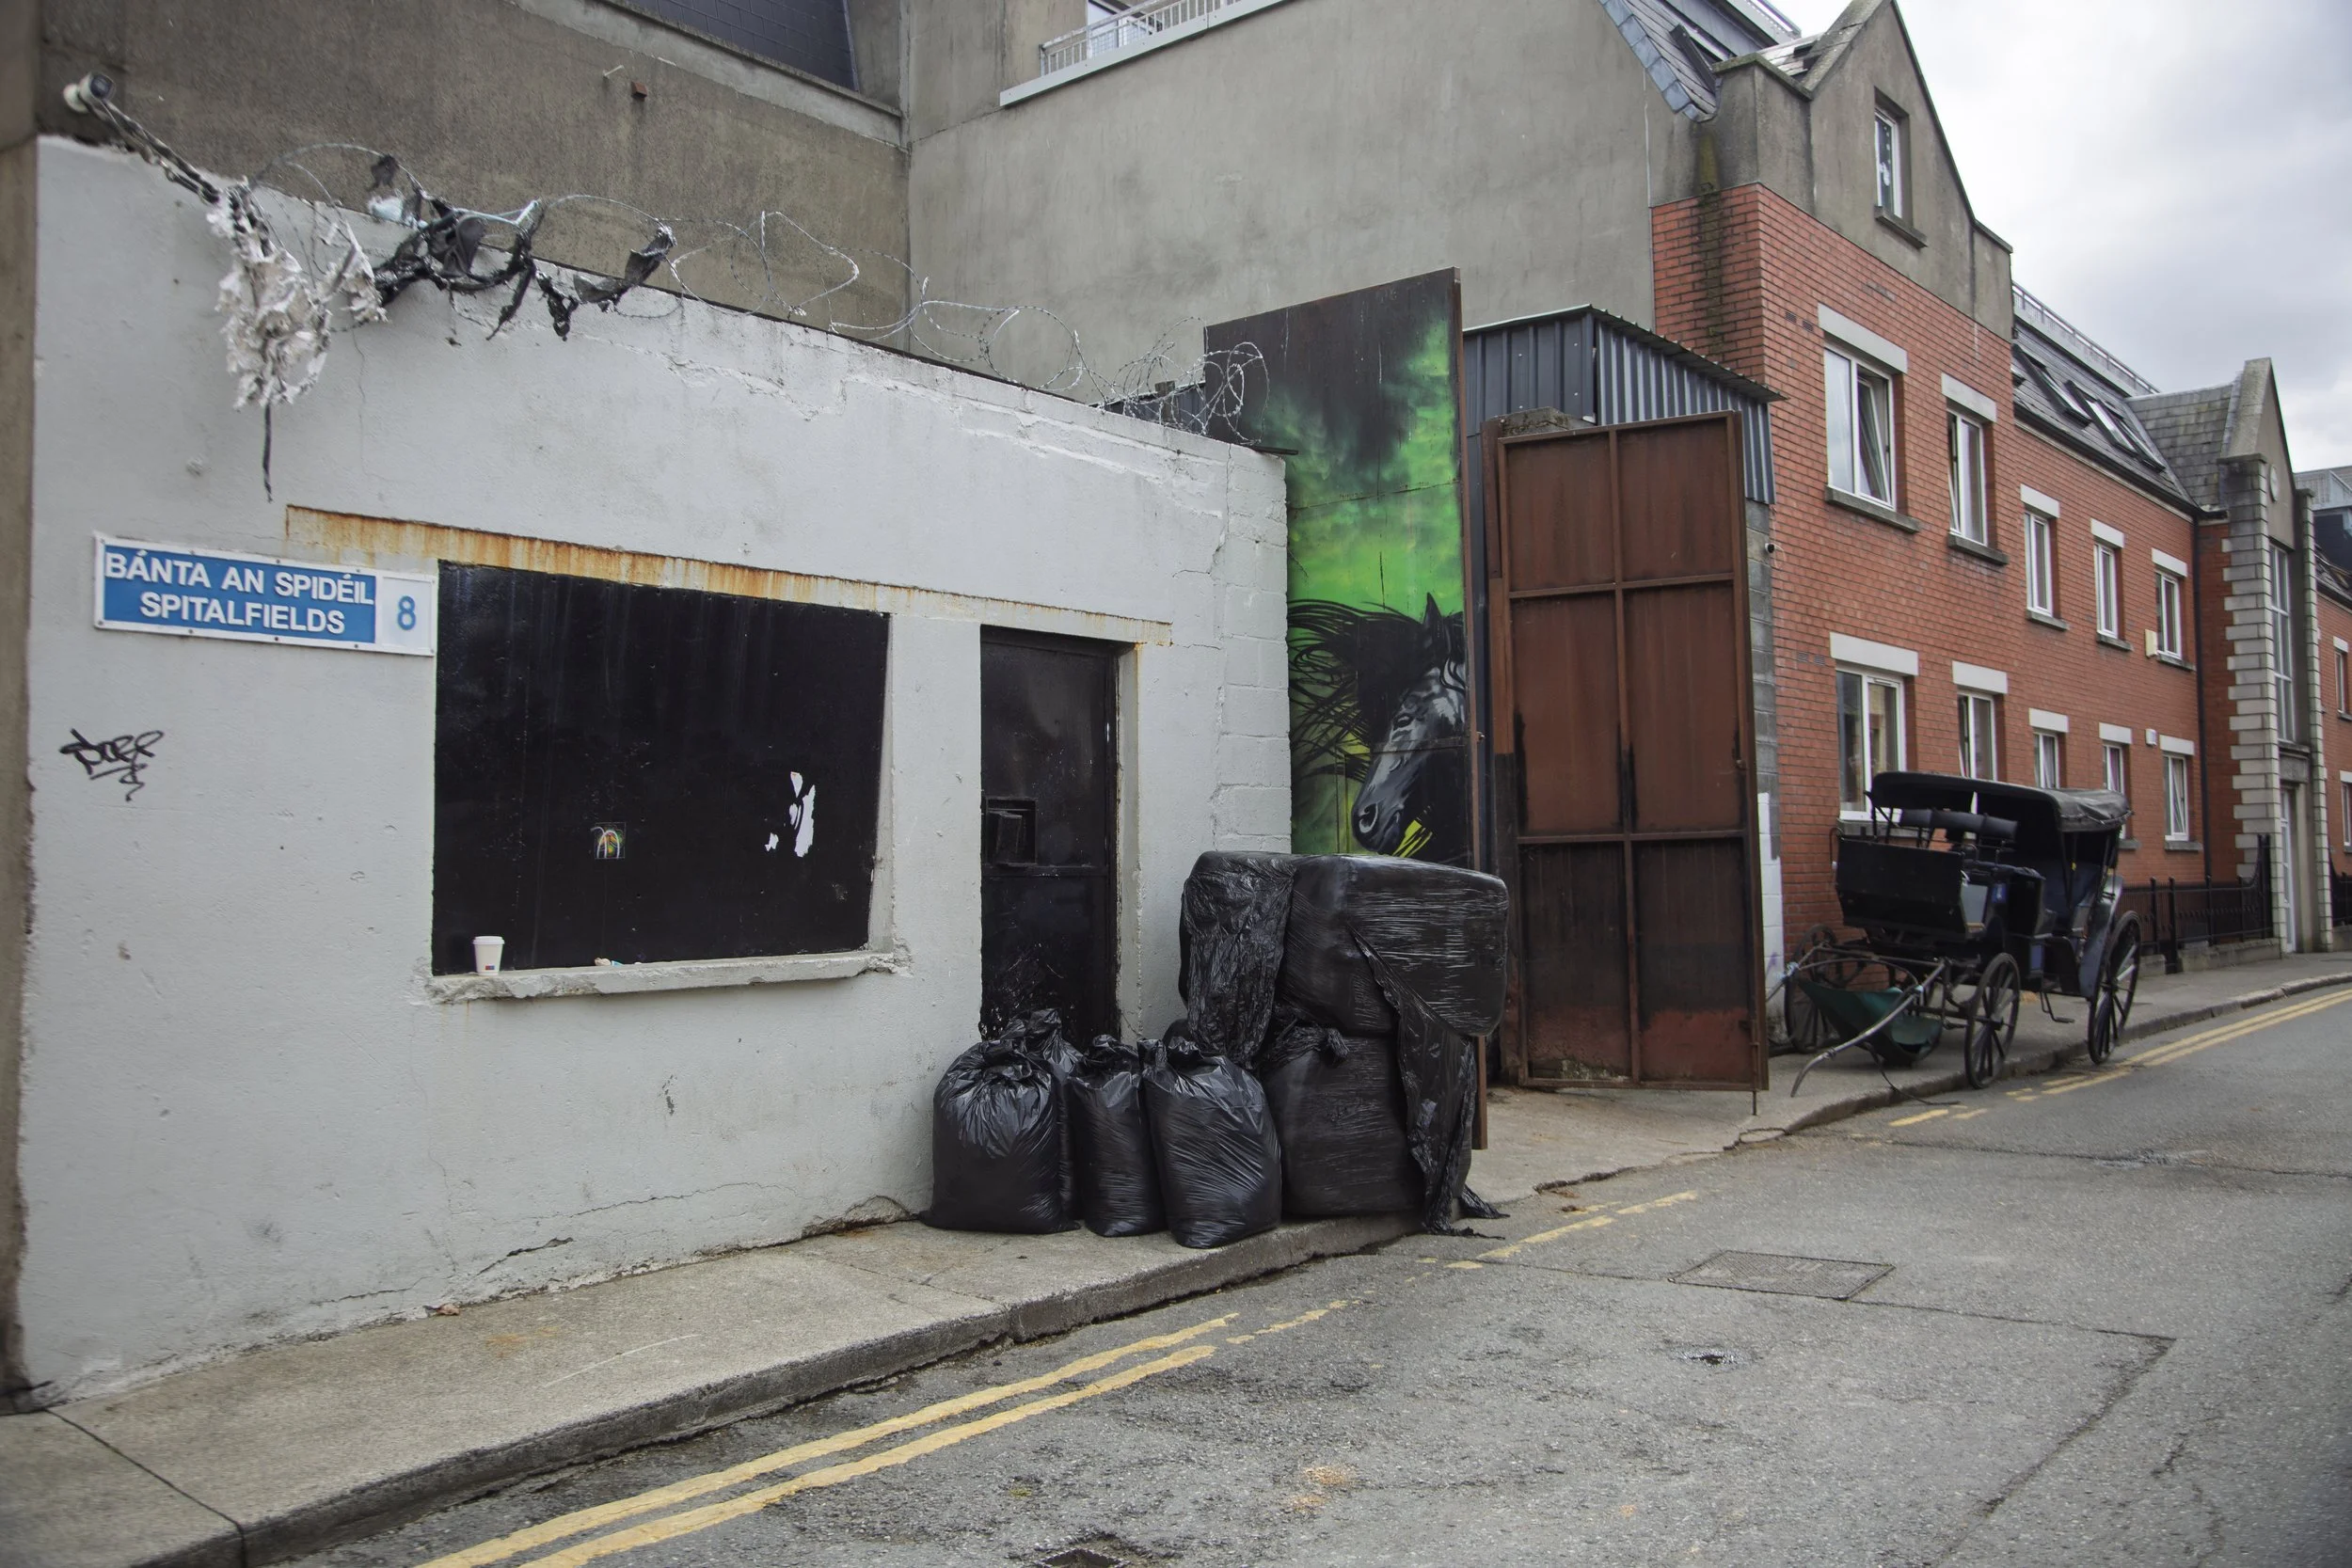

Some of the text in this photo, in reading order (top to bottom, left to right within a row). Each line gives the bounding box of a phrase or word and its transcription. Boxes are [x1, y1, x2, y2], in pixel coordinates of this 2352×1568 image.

[104, 549, 374, 605] BÁNTA AN SPIDÉIL
[140, 592, 344, 634] SPITALFIELDS
[397, 594, 417, 630] 8
